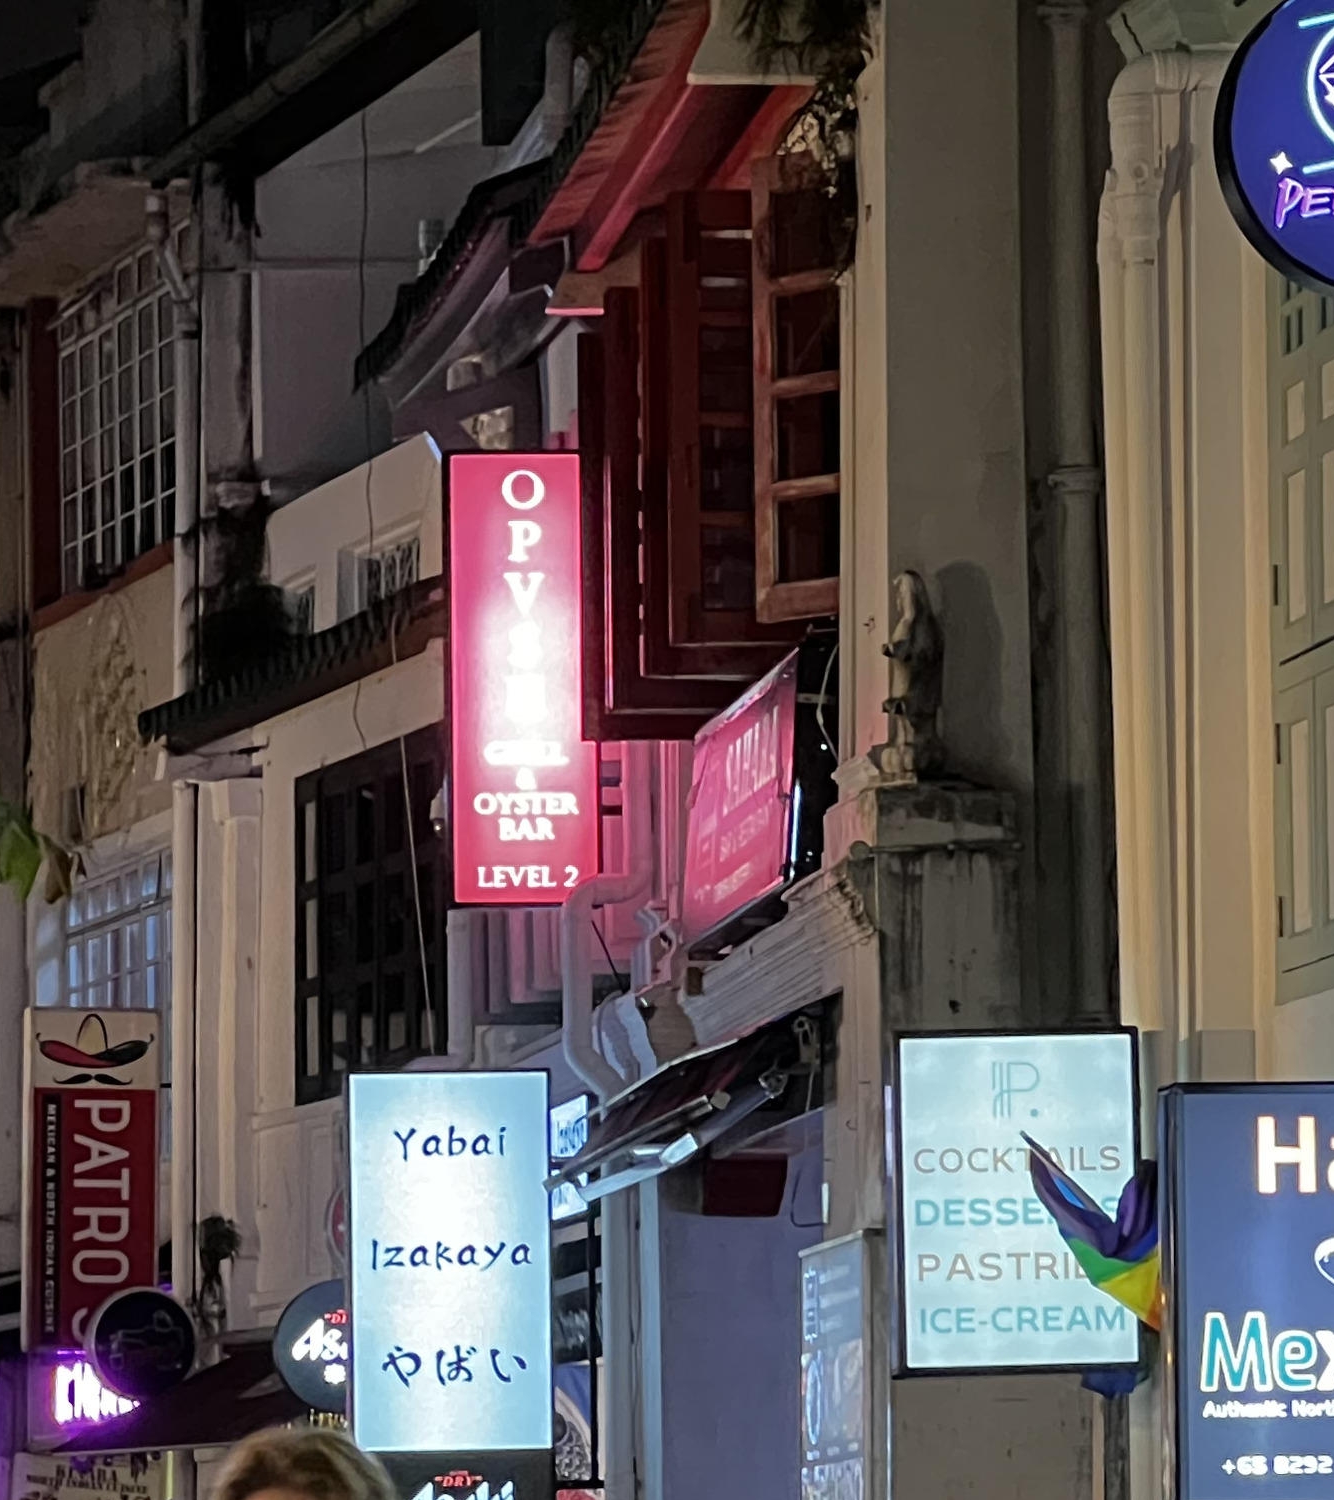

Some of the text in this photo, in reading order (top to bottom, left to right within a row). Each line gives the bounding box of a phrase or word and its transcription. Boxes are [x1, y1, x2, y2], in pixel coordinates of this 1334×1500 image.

[473, 792, 579, 815] OYSTER
[498, 817, 555, 841] BAR
[477, 864, 578, 887] LEVEL 2
[394, 1125, 507, 1160] Yabai
[915, 1197, 1118, 1227] DESSES
[371, 1240, 533, 1272] Izakaya
[918, 1252, 1091, 1282] PASTRI
[920, 1305, 1126, 1333] ICE-CREAM
[381, 1345, 528, 1387] やばい
[1221, 1454, 1268, 1477] +65
